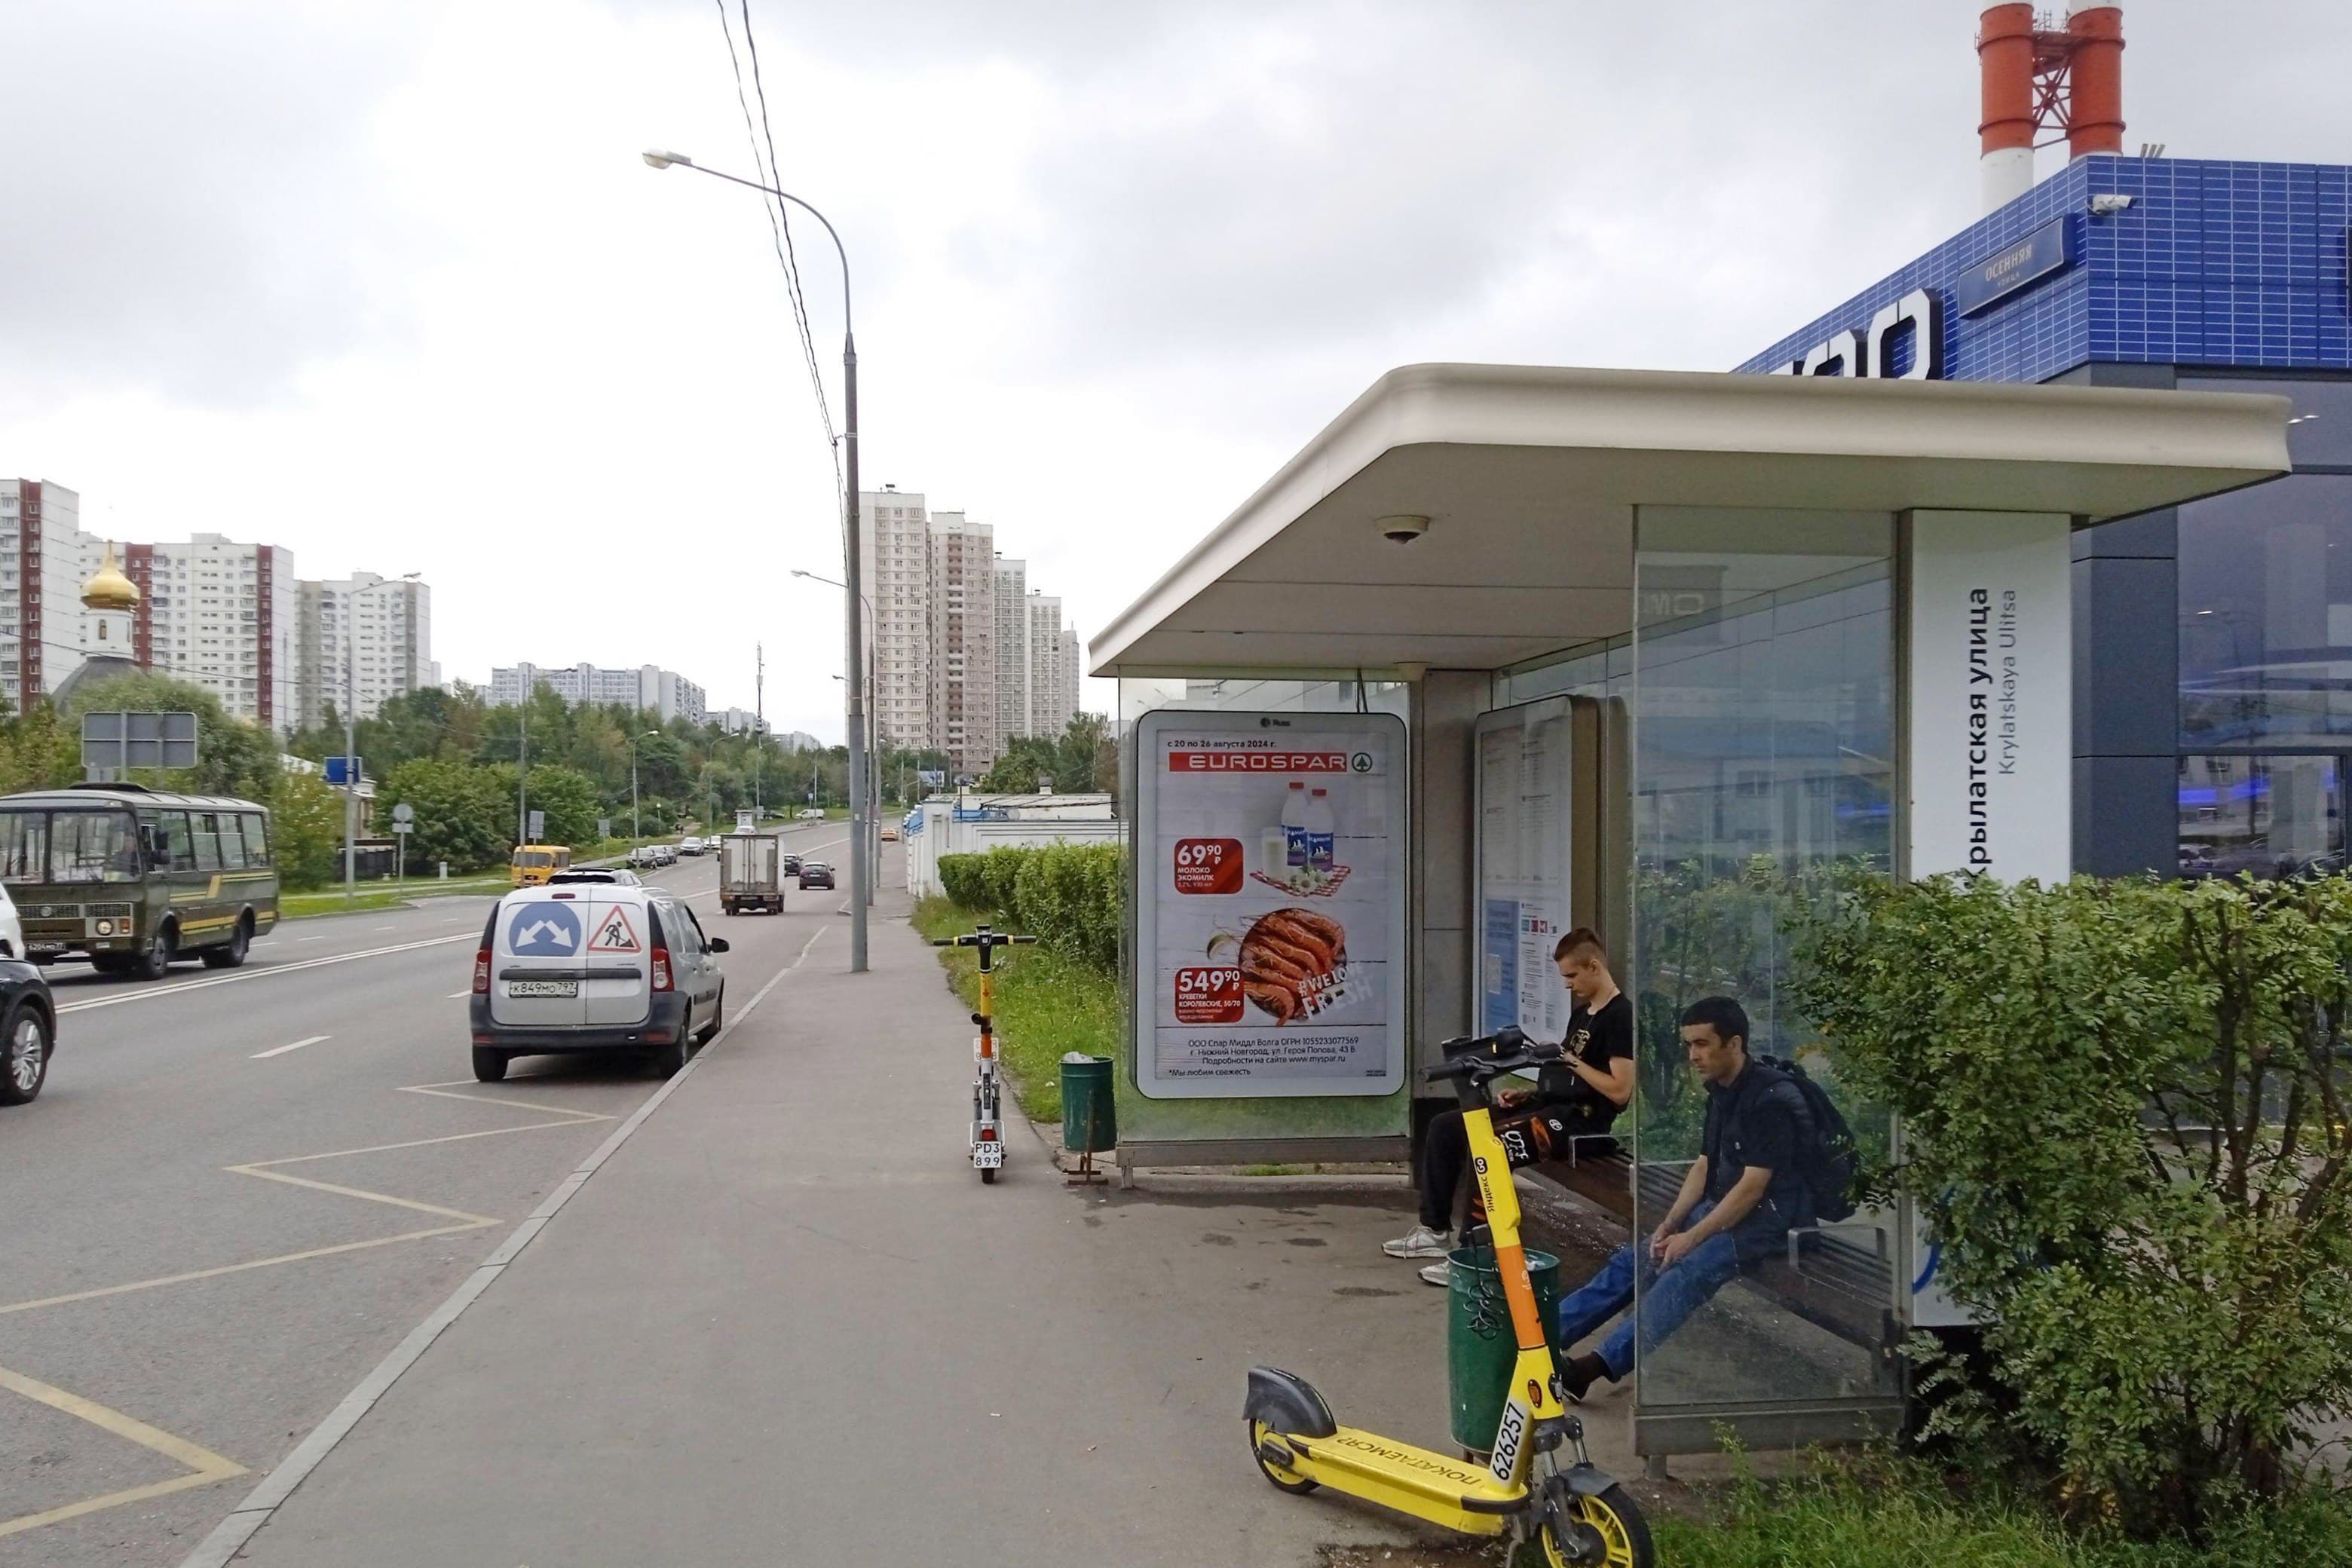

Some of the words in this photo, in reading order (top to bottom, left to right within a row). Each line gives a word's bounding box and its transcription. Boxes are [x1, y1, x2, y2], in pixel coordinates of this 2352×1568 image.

[1986, 243, 2032, 282] ОСЕННЯЯ
[1970, 587, 1993, 684] улица
[1998, 590, 2017, 648] Ulitsa
[1998, 656, 2019, 775] Krylatskaya
[1189, 755, 1346, 769] EUROSPAR
[1208, 1040, 1227, 1048] Спар
[1229, 1040, 1255, 1048] Миддл
[1257, 1038, 1279, 1046] Волга
[1285, 1046, 1306, 1055] Героя
[1202, 1057, 1253, 1065] Подробности
[975, 1143, 1000, 1153] PD3
[975, 1156, 1000, 1166] 899
[1481, 1177, 1495, 1212] Яндекс
[1493, 1401, 1525, 1481] 626257
[1337, 1438, 1481, 1486] ПОКАТАЕМСЯ?
